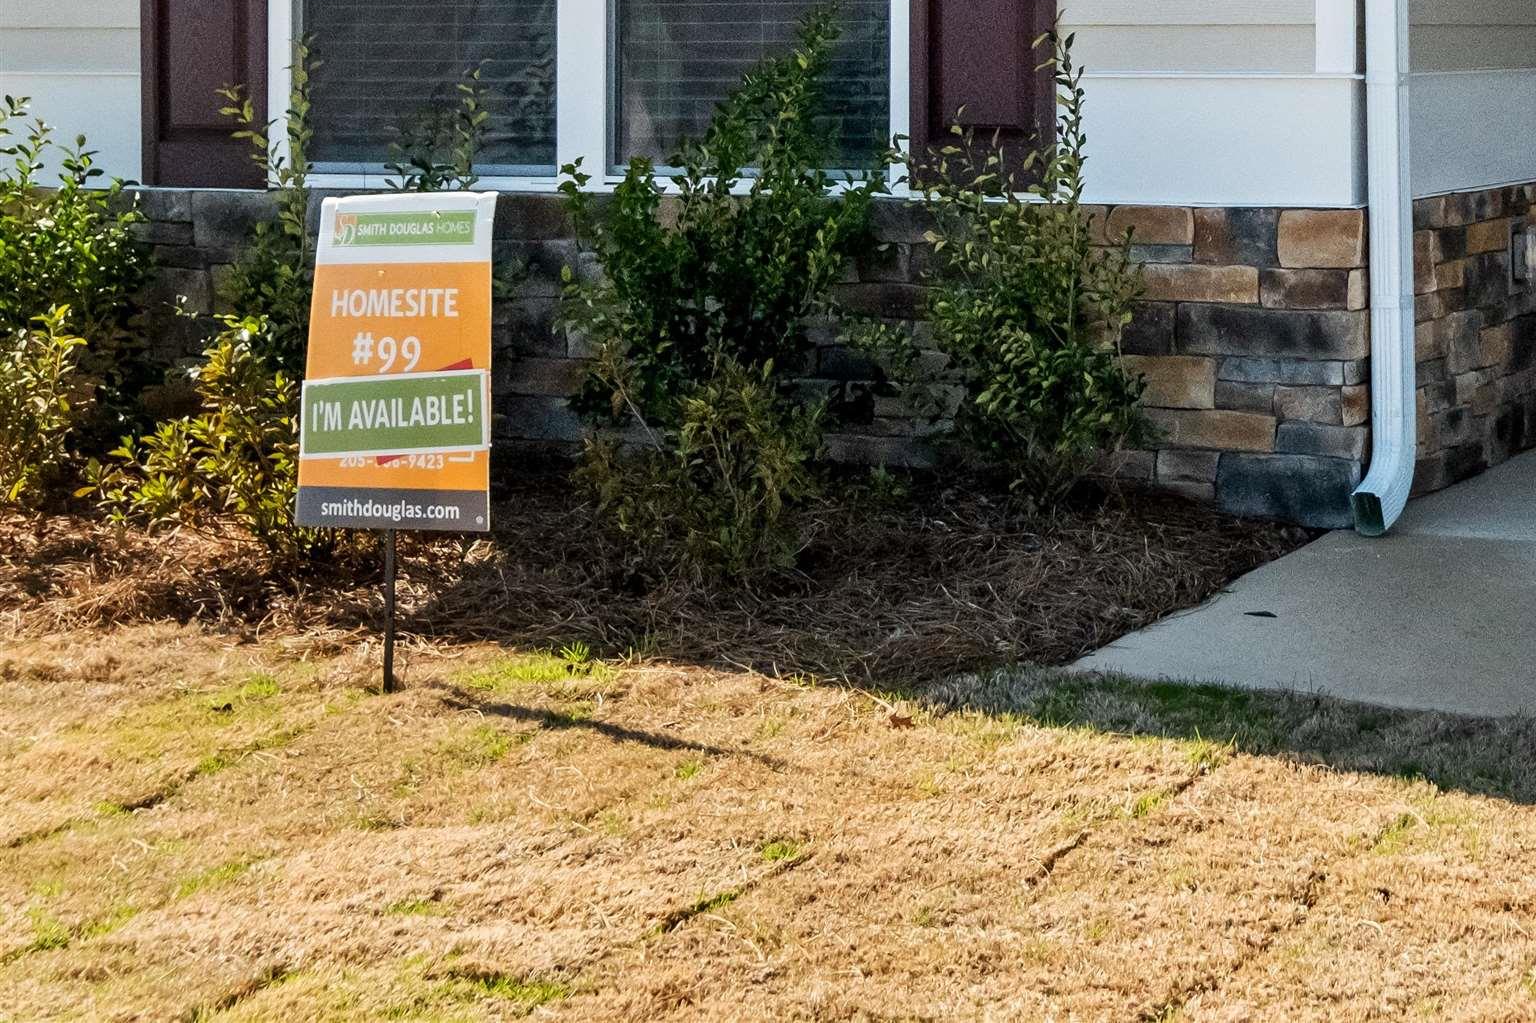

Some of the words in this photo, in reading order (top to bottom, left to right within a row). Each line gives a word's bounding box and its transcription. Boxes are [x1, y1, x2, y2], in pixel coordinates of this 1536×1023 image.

[357, 222, 388, 236] SMITH
[389, 222, 434, 235] DOUGLAS
[436, 220, 471, 234] HOMES
[330, 288, 459, 318] HOMESITE
[352, 331, 421, 374] #99
[312, 400, 342, 432] I'M
[348, 389, 474, 430] AVAILABLE!
[321, 499, 460, 521] smithdouglas.com
